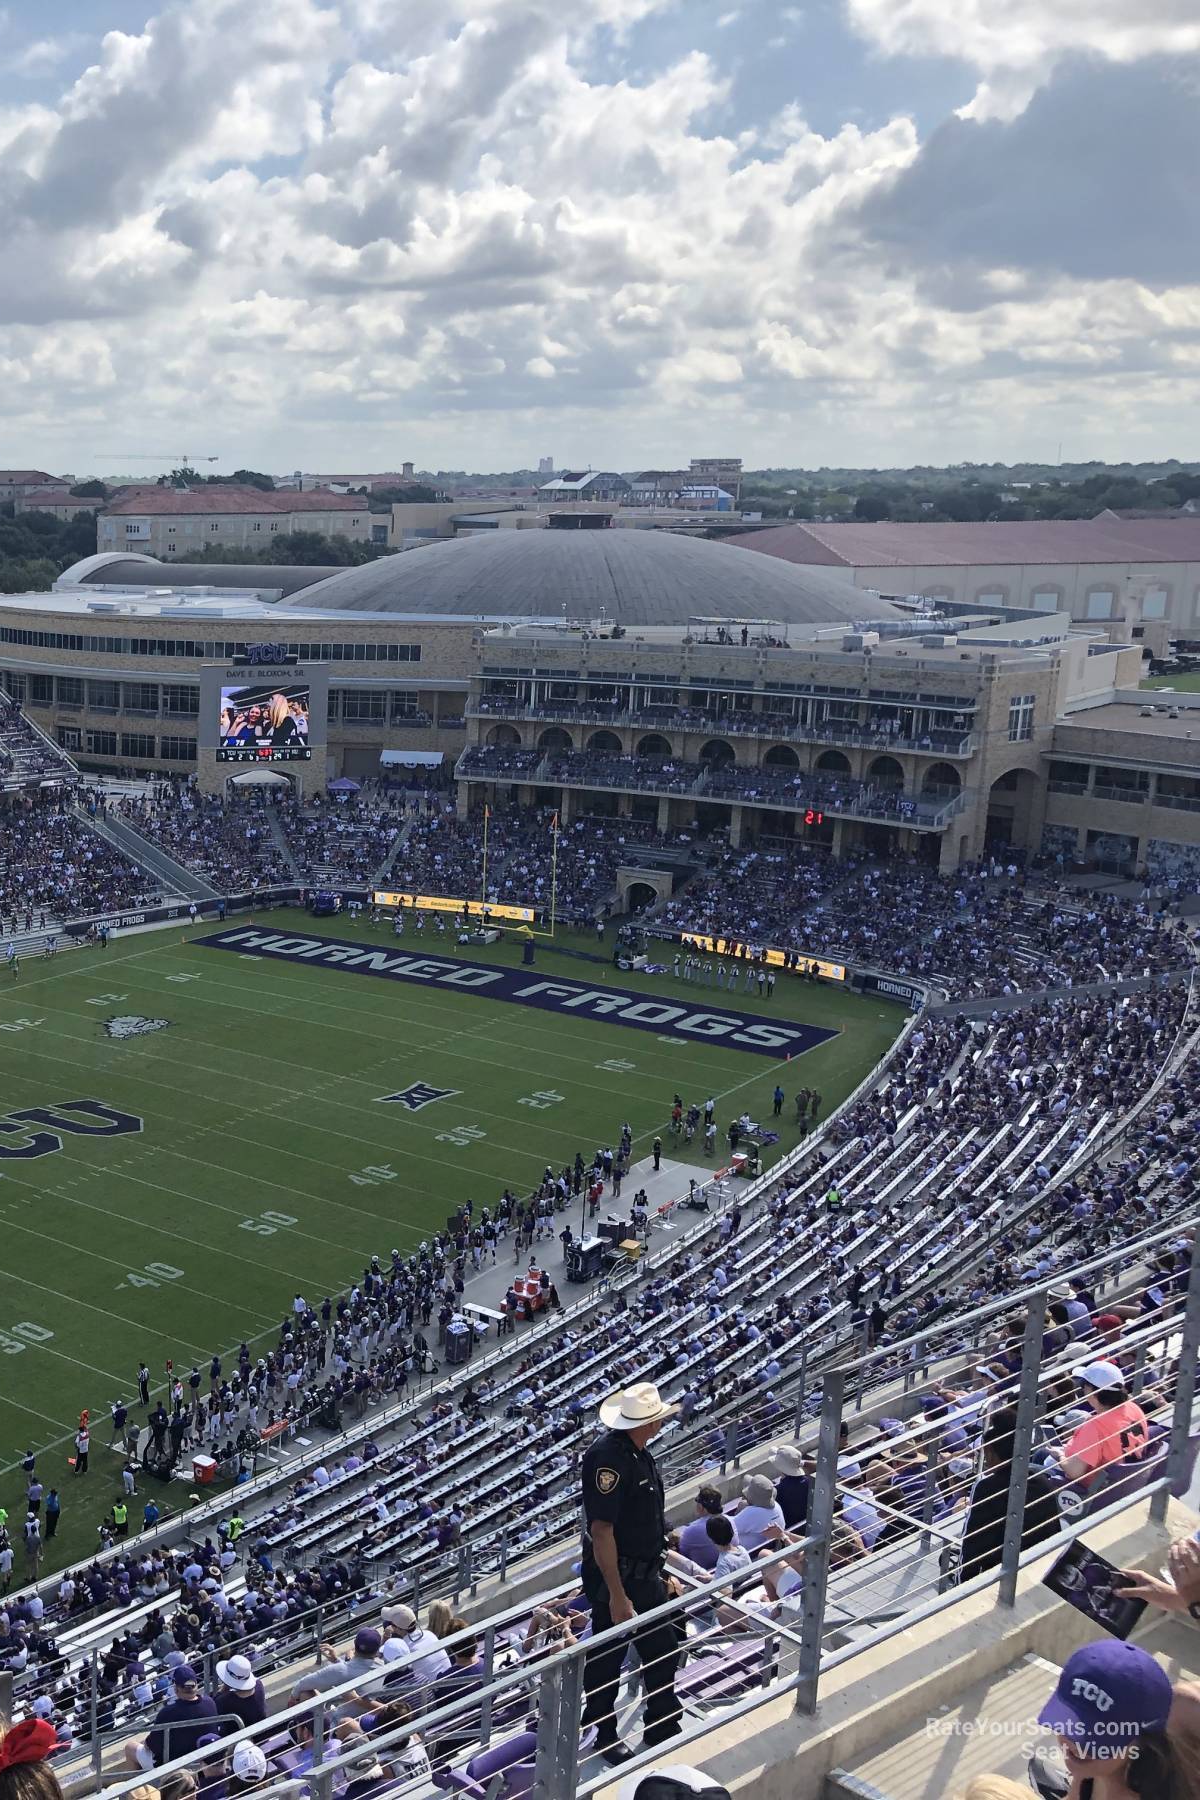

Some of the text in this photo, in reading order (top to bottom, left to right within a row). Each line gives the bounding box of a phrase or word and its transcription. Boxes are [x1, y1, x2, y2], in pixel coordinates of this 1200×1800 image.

[247, 643, 288, 664] TCU
[226, 670, 246, 678] DAVE
[122, 914, 145, 927] FROGS
[218, 931, 801, 1048] HORNED FROGS
[877, 980, 912, 998] HORNED
[517, 1090, 567, 1110] 20
[434, 1124, 487, 1146] 30
[347, 1163, 399, 1188] 40
[237, 1210, 298, 1237] 50
[125, 1262, 185, 1289] 40
[1072, 1677, 1115, 1712] TCU
